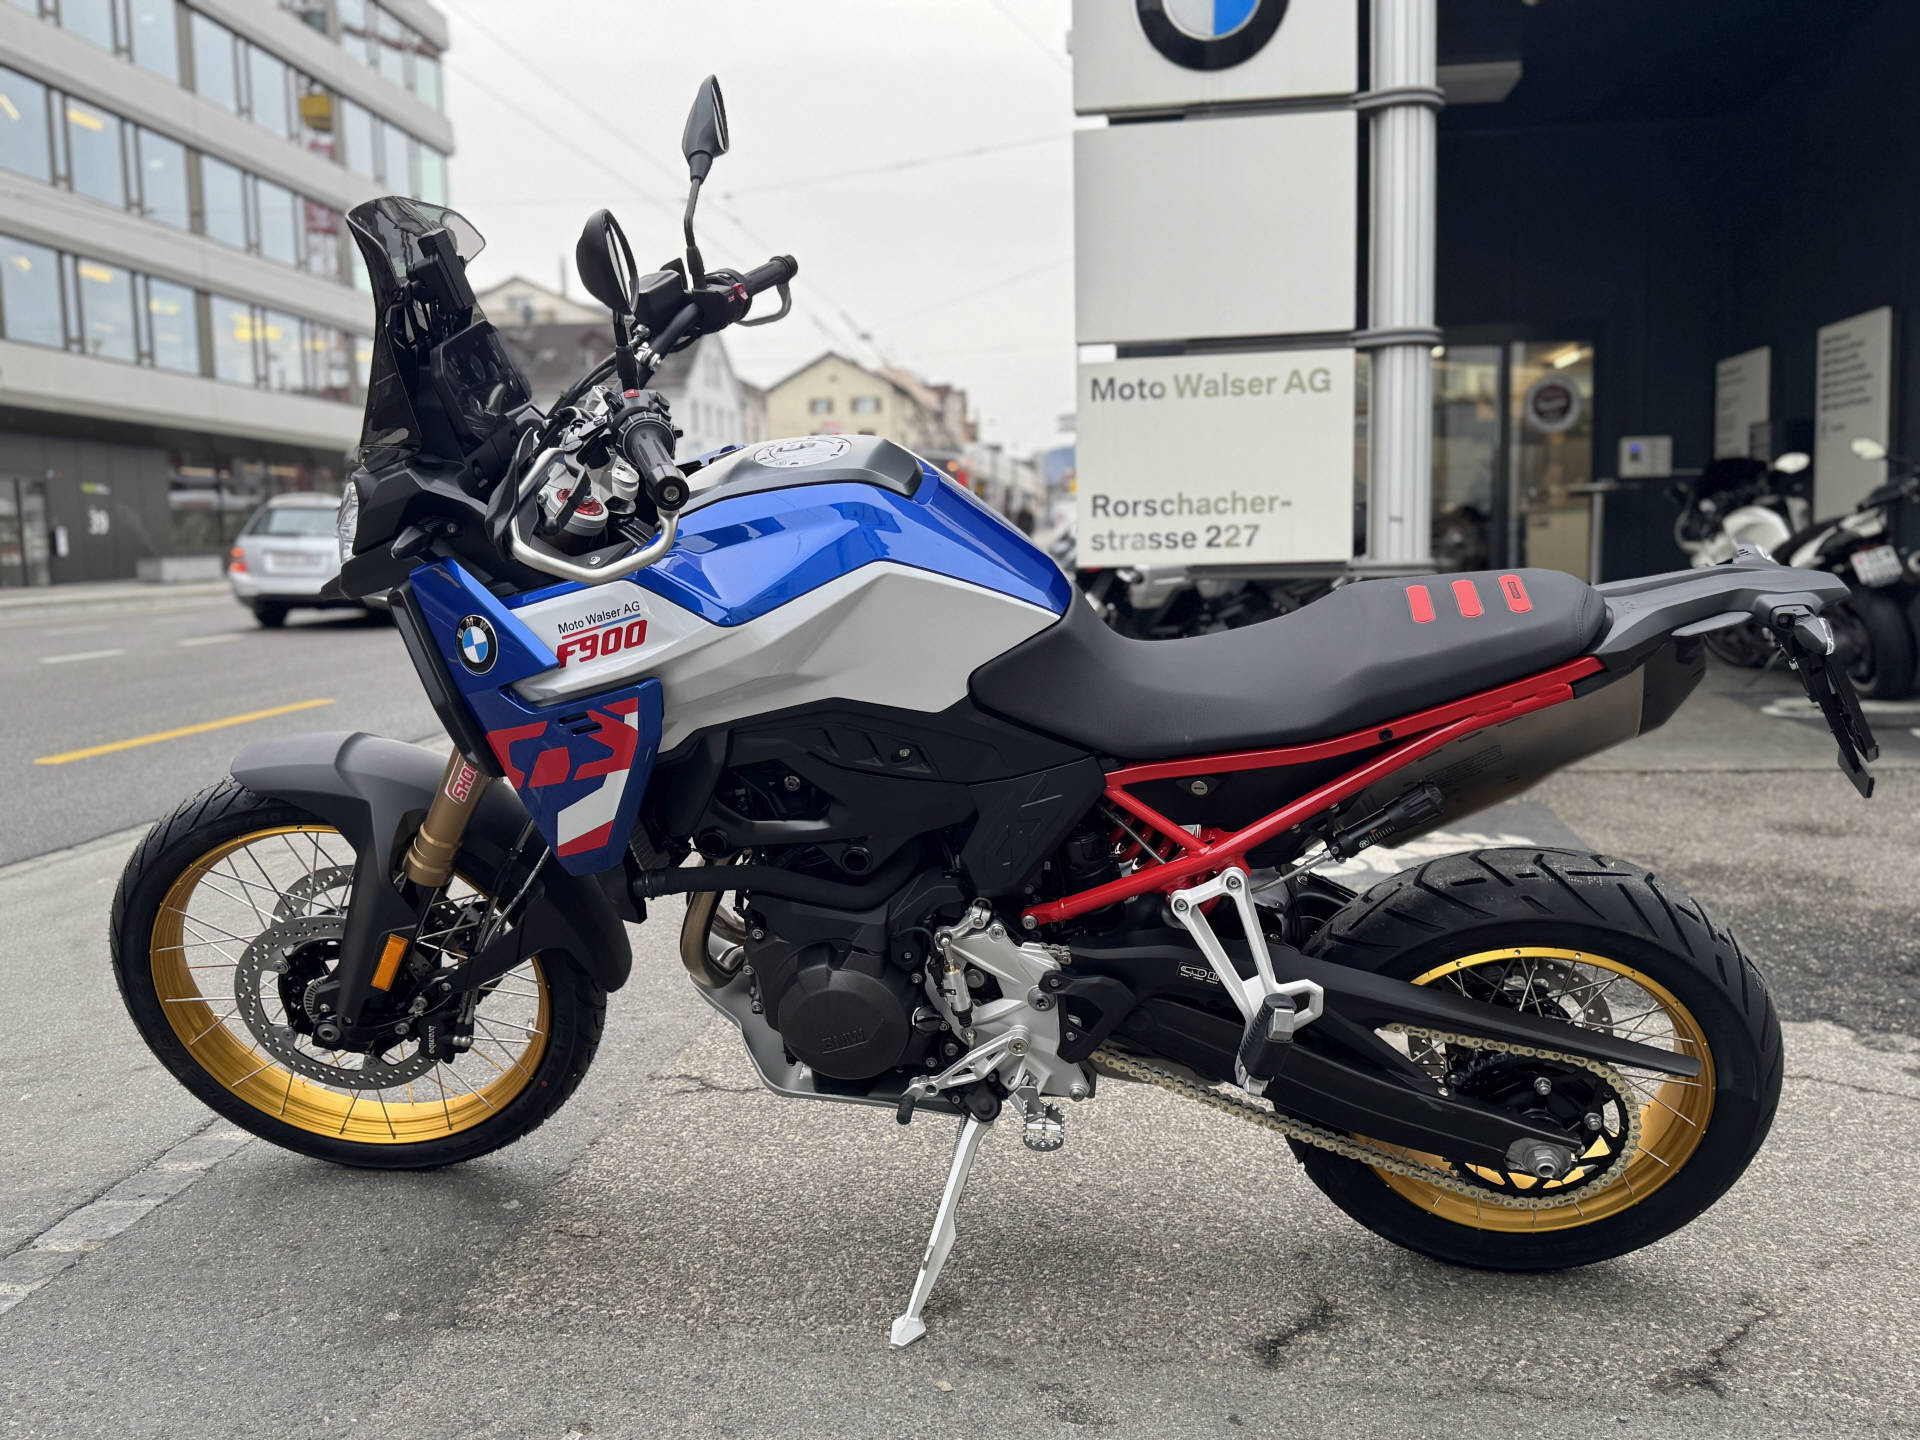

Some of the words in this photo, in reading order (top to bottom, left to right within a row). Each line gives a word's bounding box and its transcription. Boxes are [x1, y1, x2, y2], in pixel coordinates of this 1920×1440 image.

[1090, 376, 1166, 402] Moto
[1173, 371, 1278, 399] Walser
[1283, 367, 1332, 394] AG
[1090, 491, 1293, 518] Rorschacher-
[1090, 529, 1198, 552] strasse
[1204, 523, 1260, 549] 227
[456, 616, 489, 640] BMW
[557, 620, 585, 634] Moto
[585, 608, 621, 625] Walser
[623, 600, 640, 615] AG
[556, 619, 648, 669] F900
[452, 761, 479, 803] SHO
